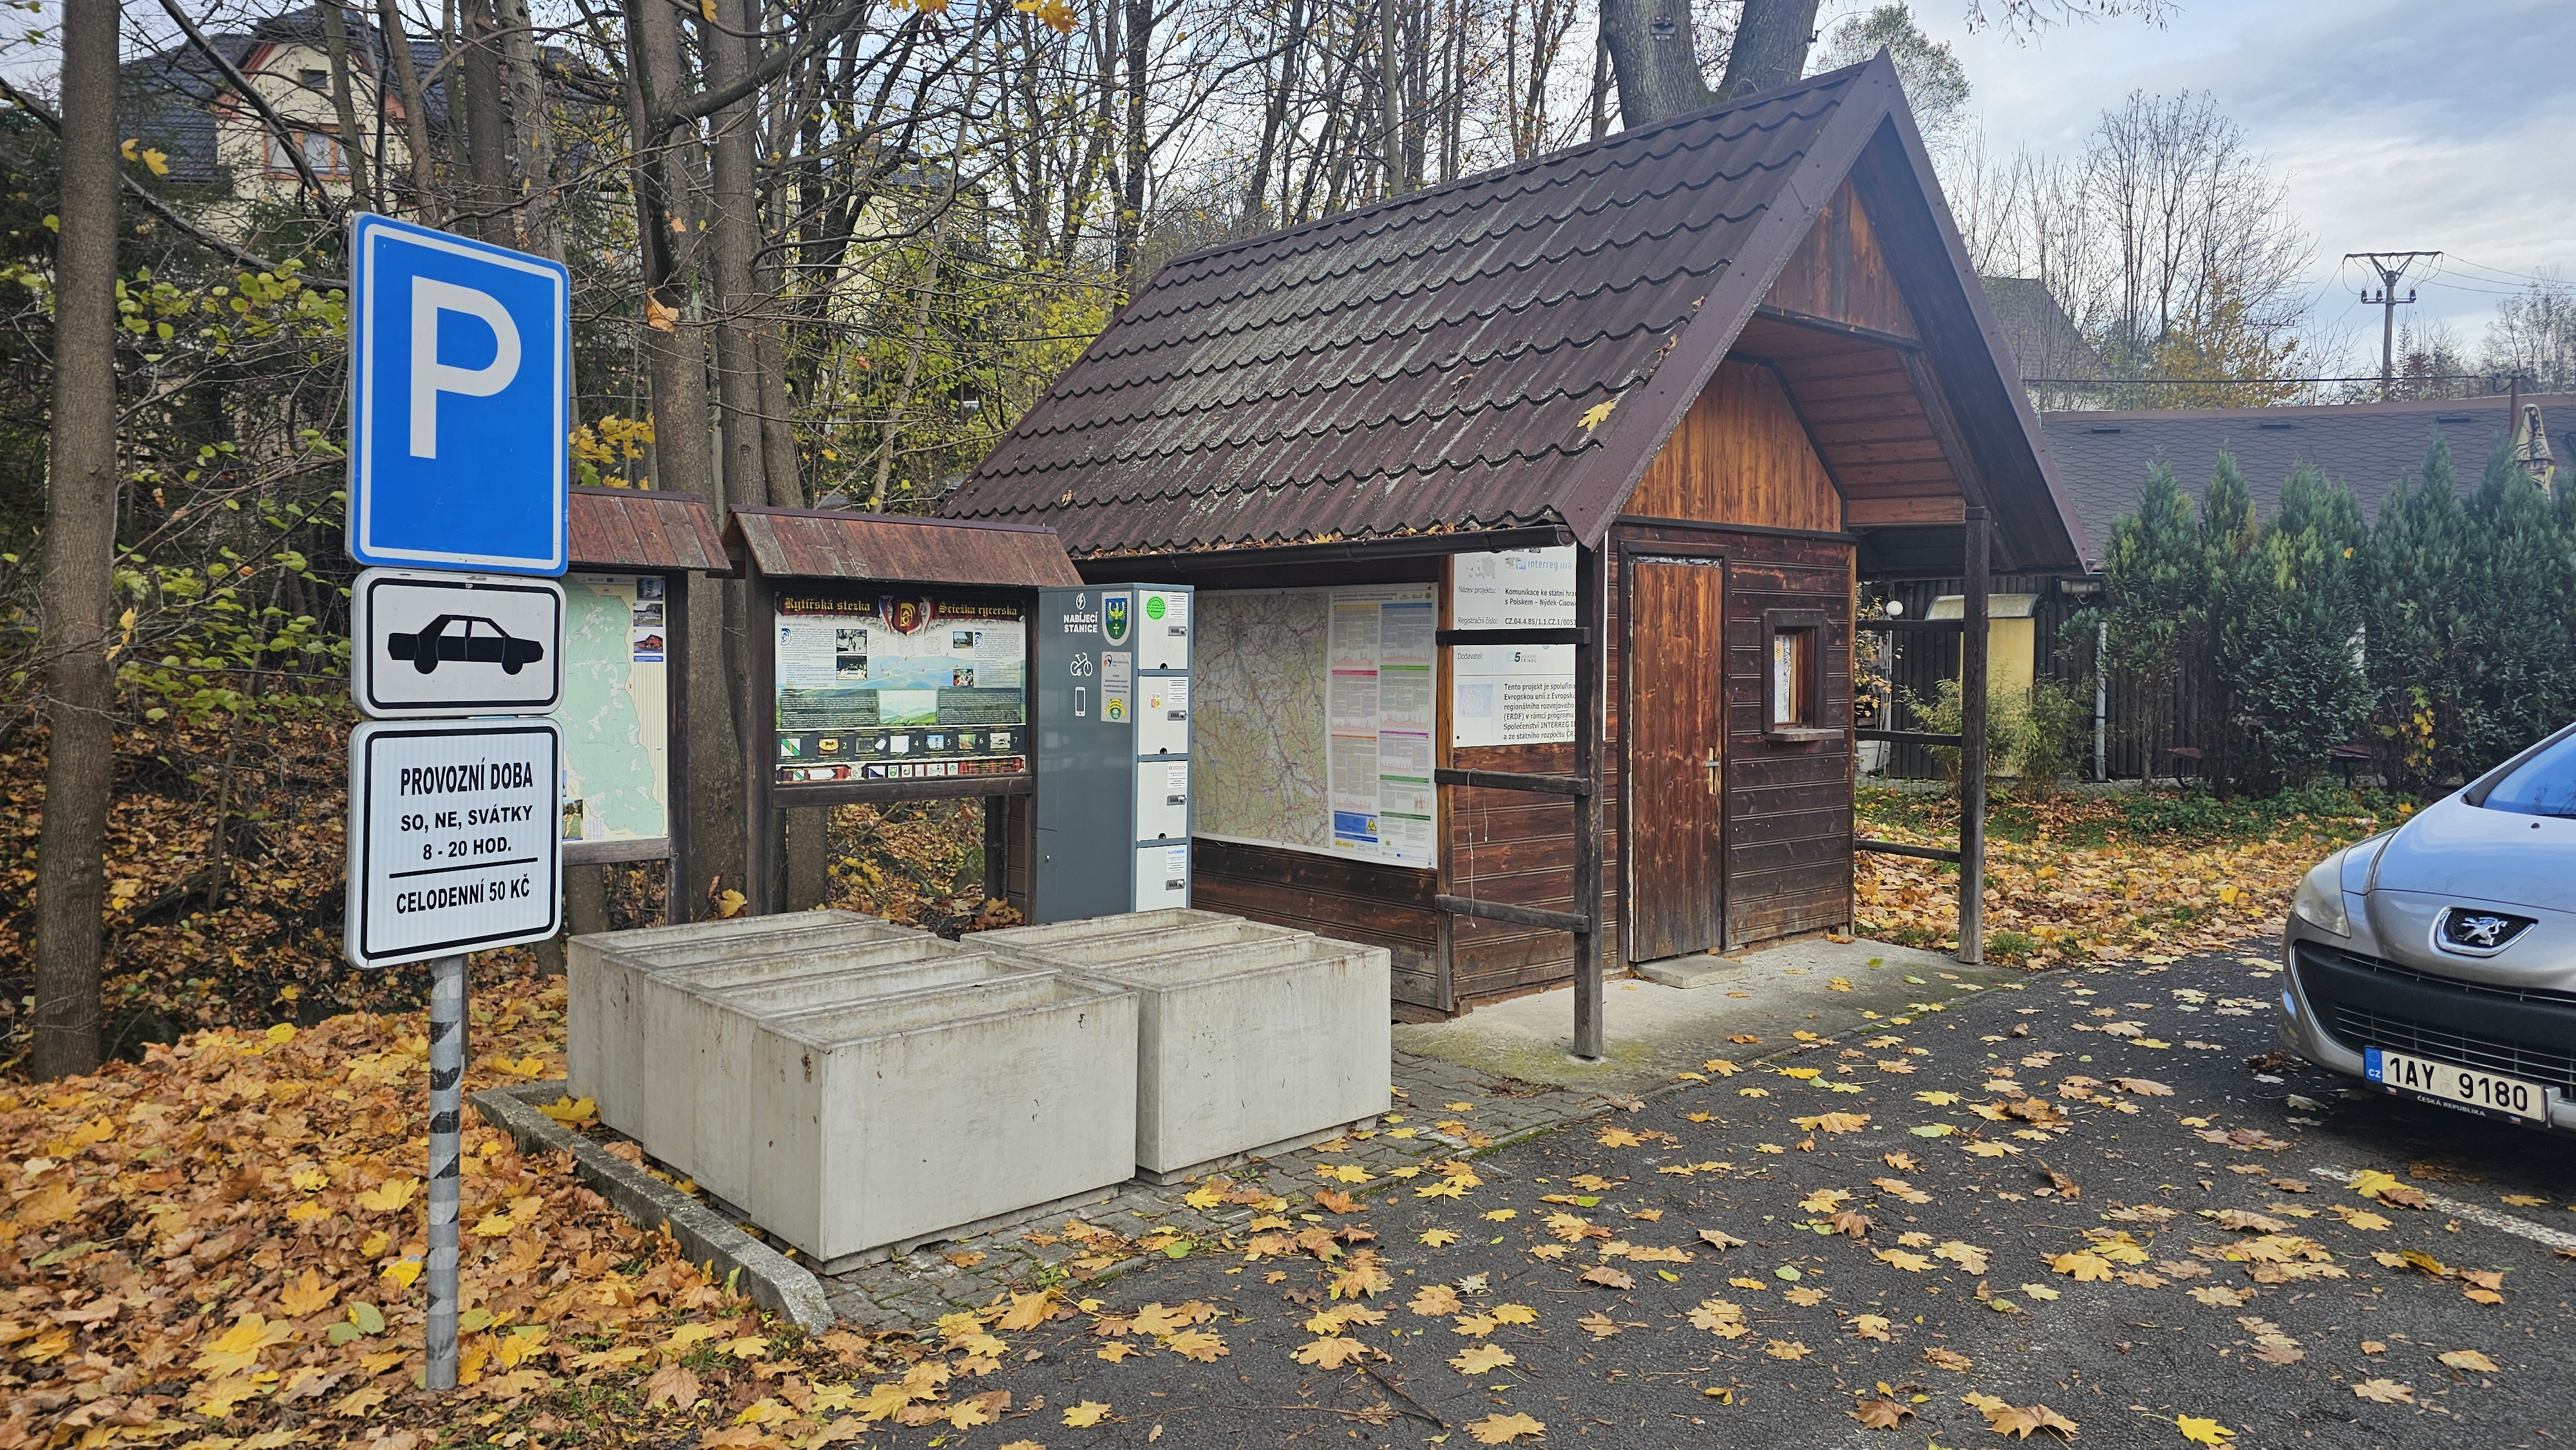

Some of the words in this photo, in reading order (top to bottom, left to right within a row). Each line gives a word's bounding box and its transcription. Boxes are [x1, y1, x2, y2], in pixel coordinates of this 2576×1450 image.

[410, 275, 522, 460] P
[1474, 587, 1496, 595] projektu:
[784, 598, 833, 612] Rytířská
[837, 600, 871, 611] stezka
[978, 605, 1018, 616] rycerska
[1063, 611, 1098, 623] NABÍJECÍ
[1457, 617, 1484, 625] Registrační
[1485, 616, 1499, 625] číslo:
[1064, 624, 1098, 633] STANICE
[1522, 683, 1542, 691] projekt
[1504, 693, 1533, 701] Evropskou
[1504, 702, 1539, 711] regionálního
[1540, 701, 1574, 710] rozvojového
[1504, 713, 1524, 721] (ERDF)
[1504, 721, 1539, 731] Společenství
[1540, 720, 1569, 729] INTERREG
[1516, 731, 1539, 740] státního
[1540, 730, 1565, 739] rozpočtu
[401, 757, 486, 796] PROVOZNÍ
[491, 762, 533, 790] DOBA
[401, 815, 429, 833] SO,
[435, 811, 462, 831] NE,
[468, 804, 533, 825] SVÁTKY
[423, 843, 432, 860] 8
[448, 840, 468, 858] 20
[473, 837, 511, 855] HOD.
[396, 878, 484, 914] CELODENNÍ
[489, 881, 506, 901] 50
[511, 873, 530, 898] KČ
[2368, 1068, 2382, 1078] CZ
[2390, 1057, 2436, 1091] 1AY
[2459, 1073, 2528, 1112] 9180
[2416, 1093, 2441, 1107] ČESKÁ
[2443, 1101, 2486, 1117] REPUBLIKA
